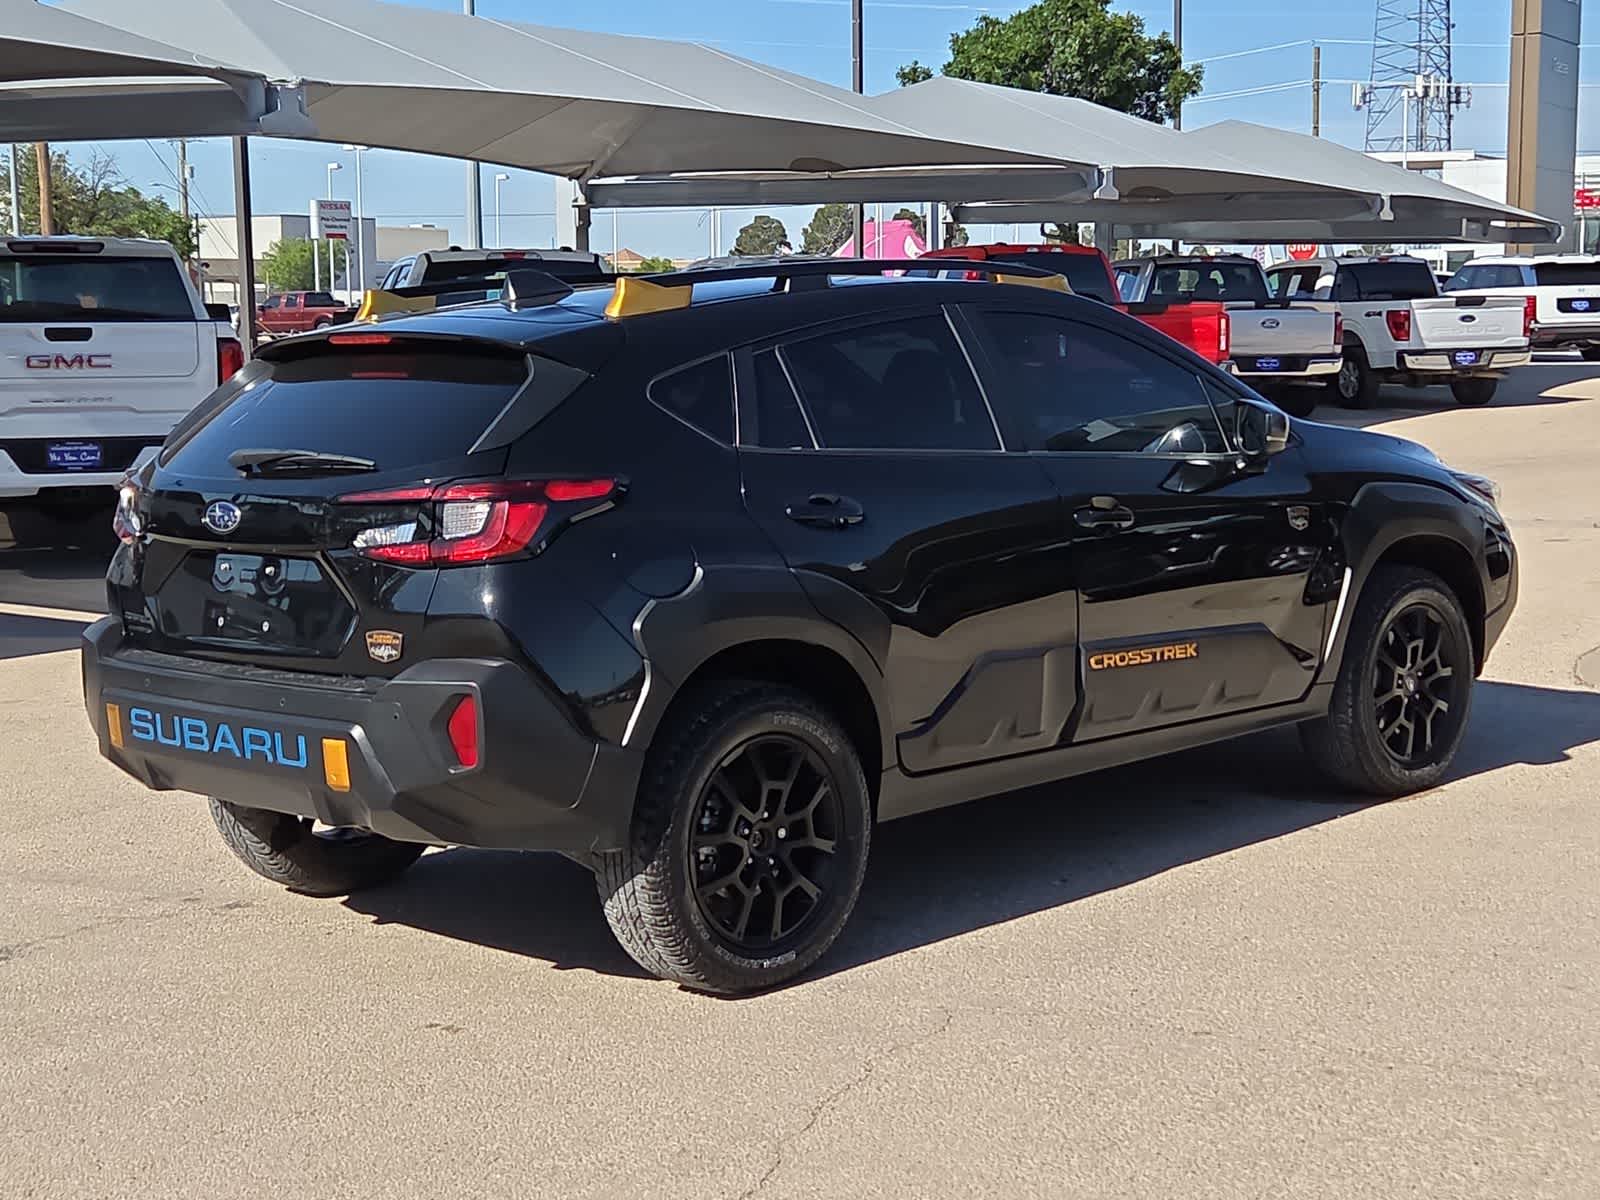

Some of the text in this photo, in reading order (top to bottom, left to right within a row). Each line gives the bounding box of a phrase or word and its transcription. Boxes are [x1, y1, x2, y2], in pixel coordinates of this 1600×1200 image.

[26, 353, 112, 369] GMC
[1089, 642, 1198, 670] CROSSTREK
[130, 707, 308, 769] SUBARU
